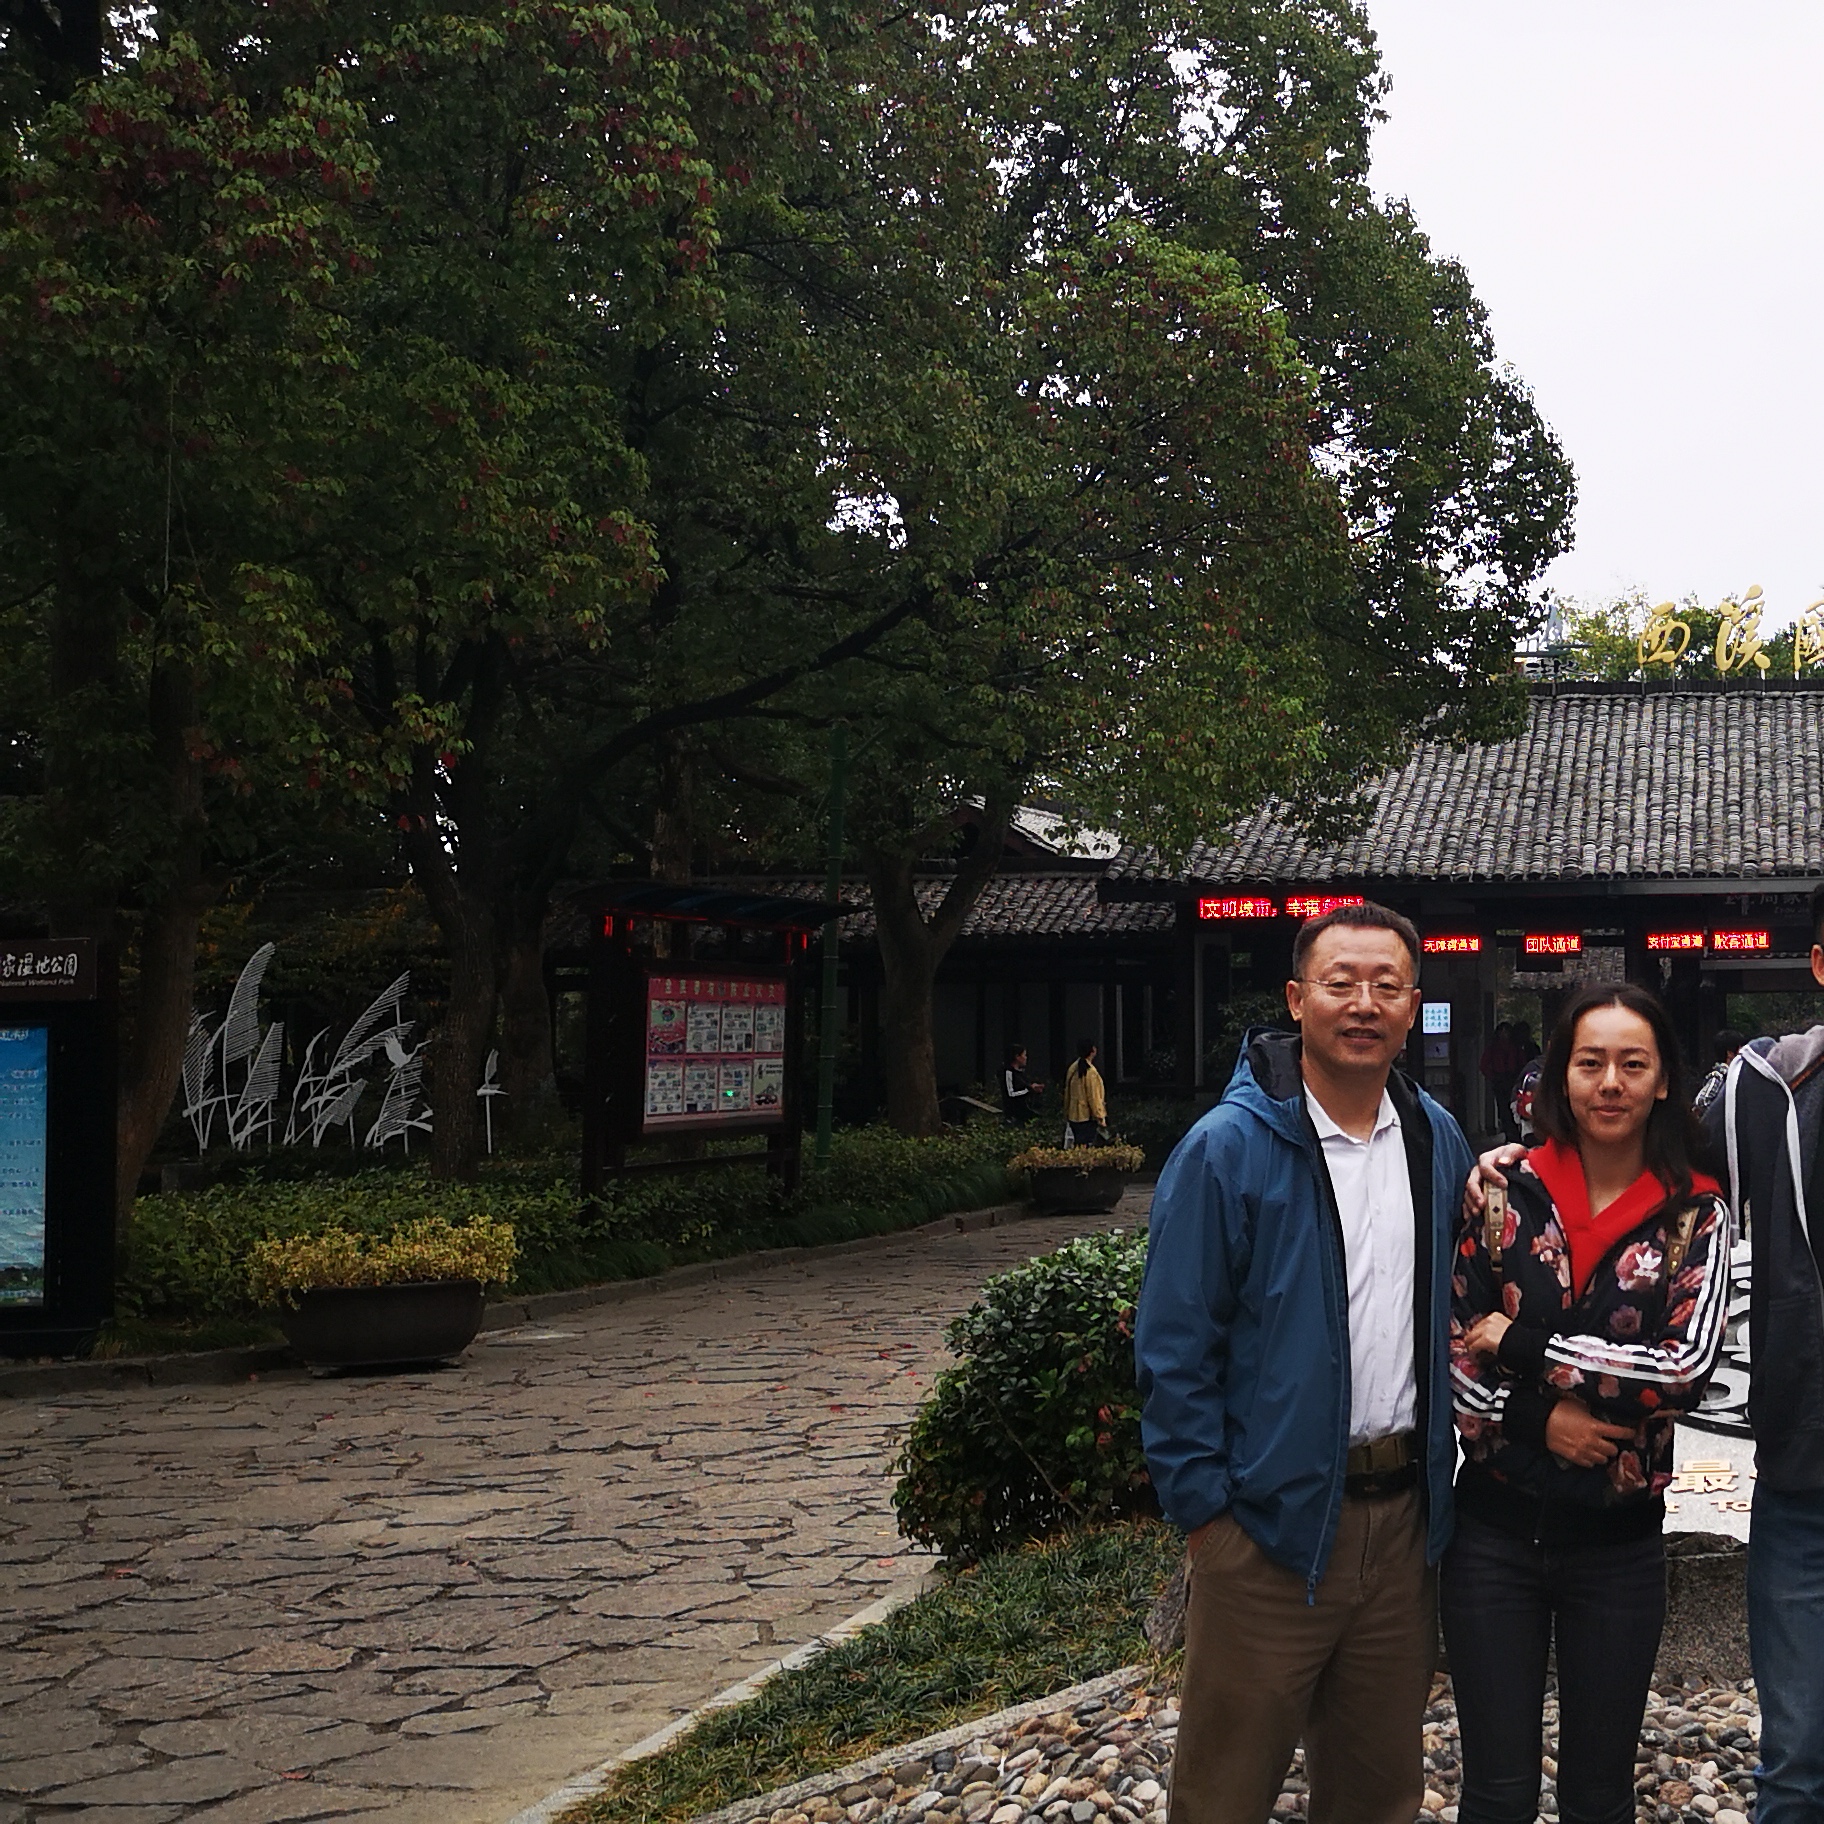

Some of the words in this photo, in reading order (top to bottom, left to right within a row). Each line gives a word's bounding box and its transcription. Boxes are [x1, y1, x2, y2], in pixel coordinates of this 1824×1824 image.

[1526, 936, 1581, 953] 团队通道
[1672, 1460, 1739, 1493] 最
